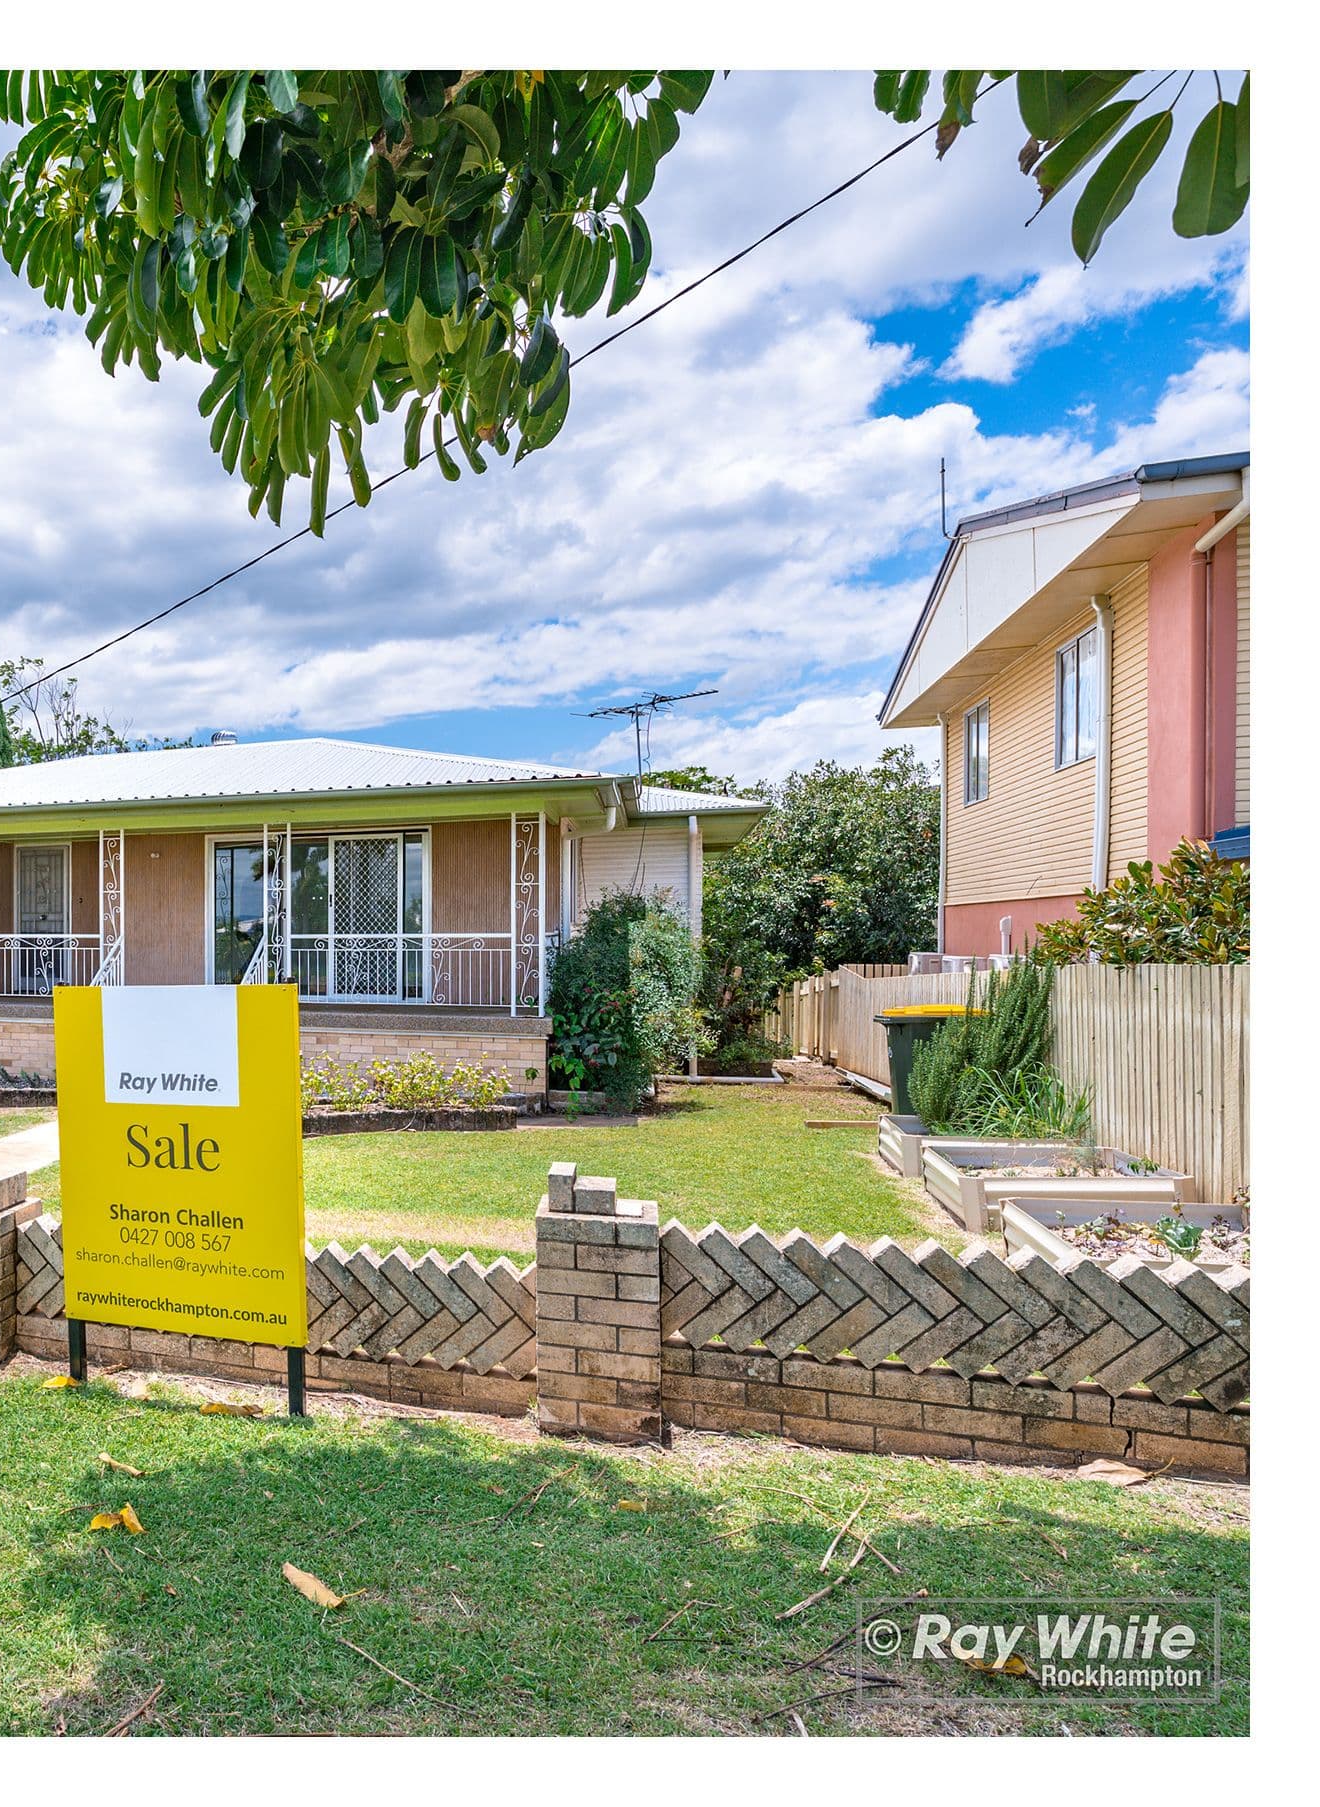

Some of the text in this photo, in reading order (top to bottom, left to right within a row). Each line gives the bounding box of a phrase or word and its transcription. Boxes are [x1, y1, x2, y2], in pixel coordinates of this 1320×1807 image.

[119, 1072, 219, 1093] Ray White
[126, 1123, 221, 1172] Sale
[109, 1204, 244, 1230] Sharon Challen
[119, 1227, 231, 1252] 0427 008 567
[75, 1248, 285, 1281] sharon.challen@raywhite.com
[76, 1288, 287, 1326] raywhiterockhampton.com.au
